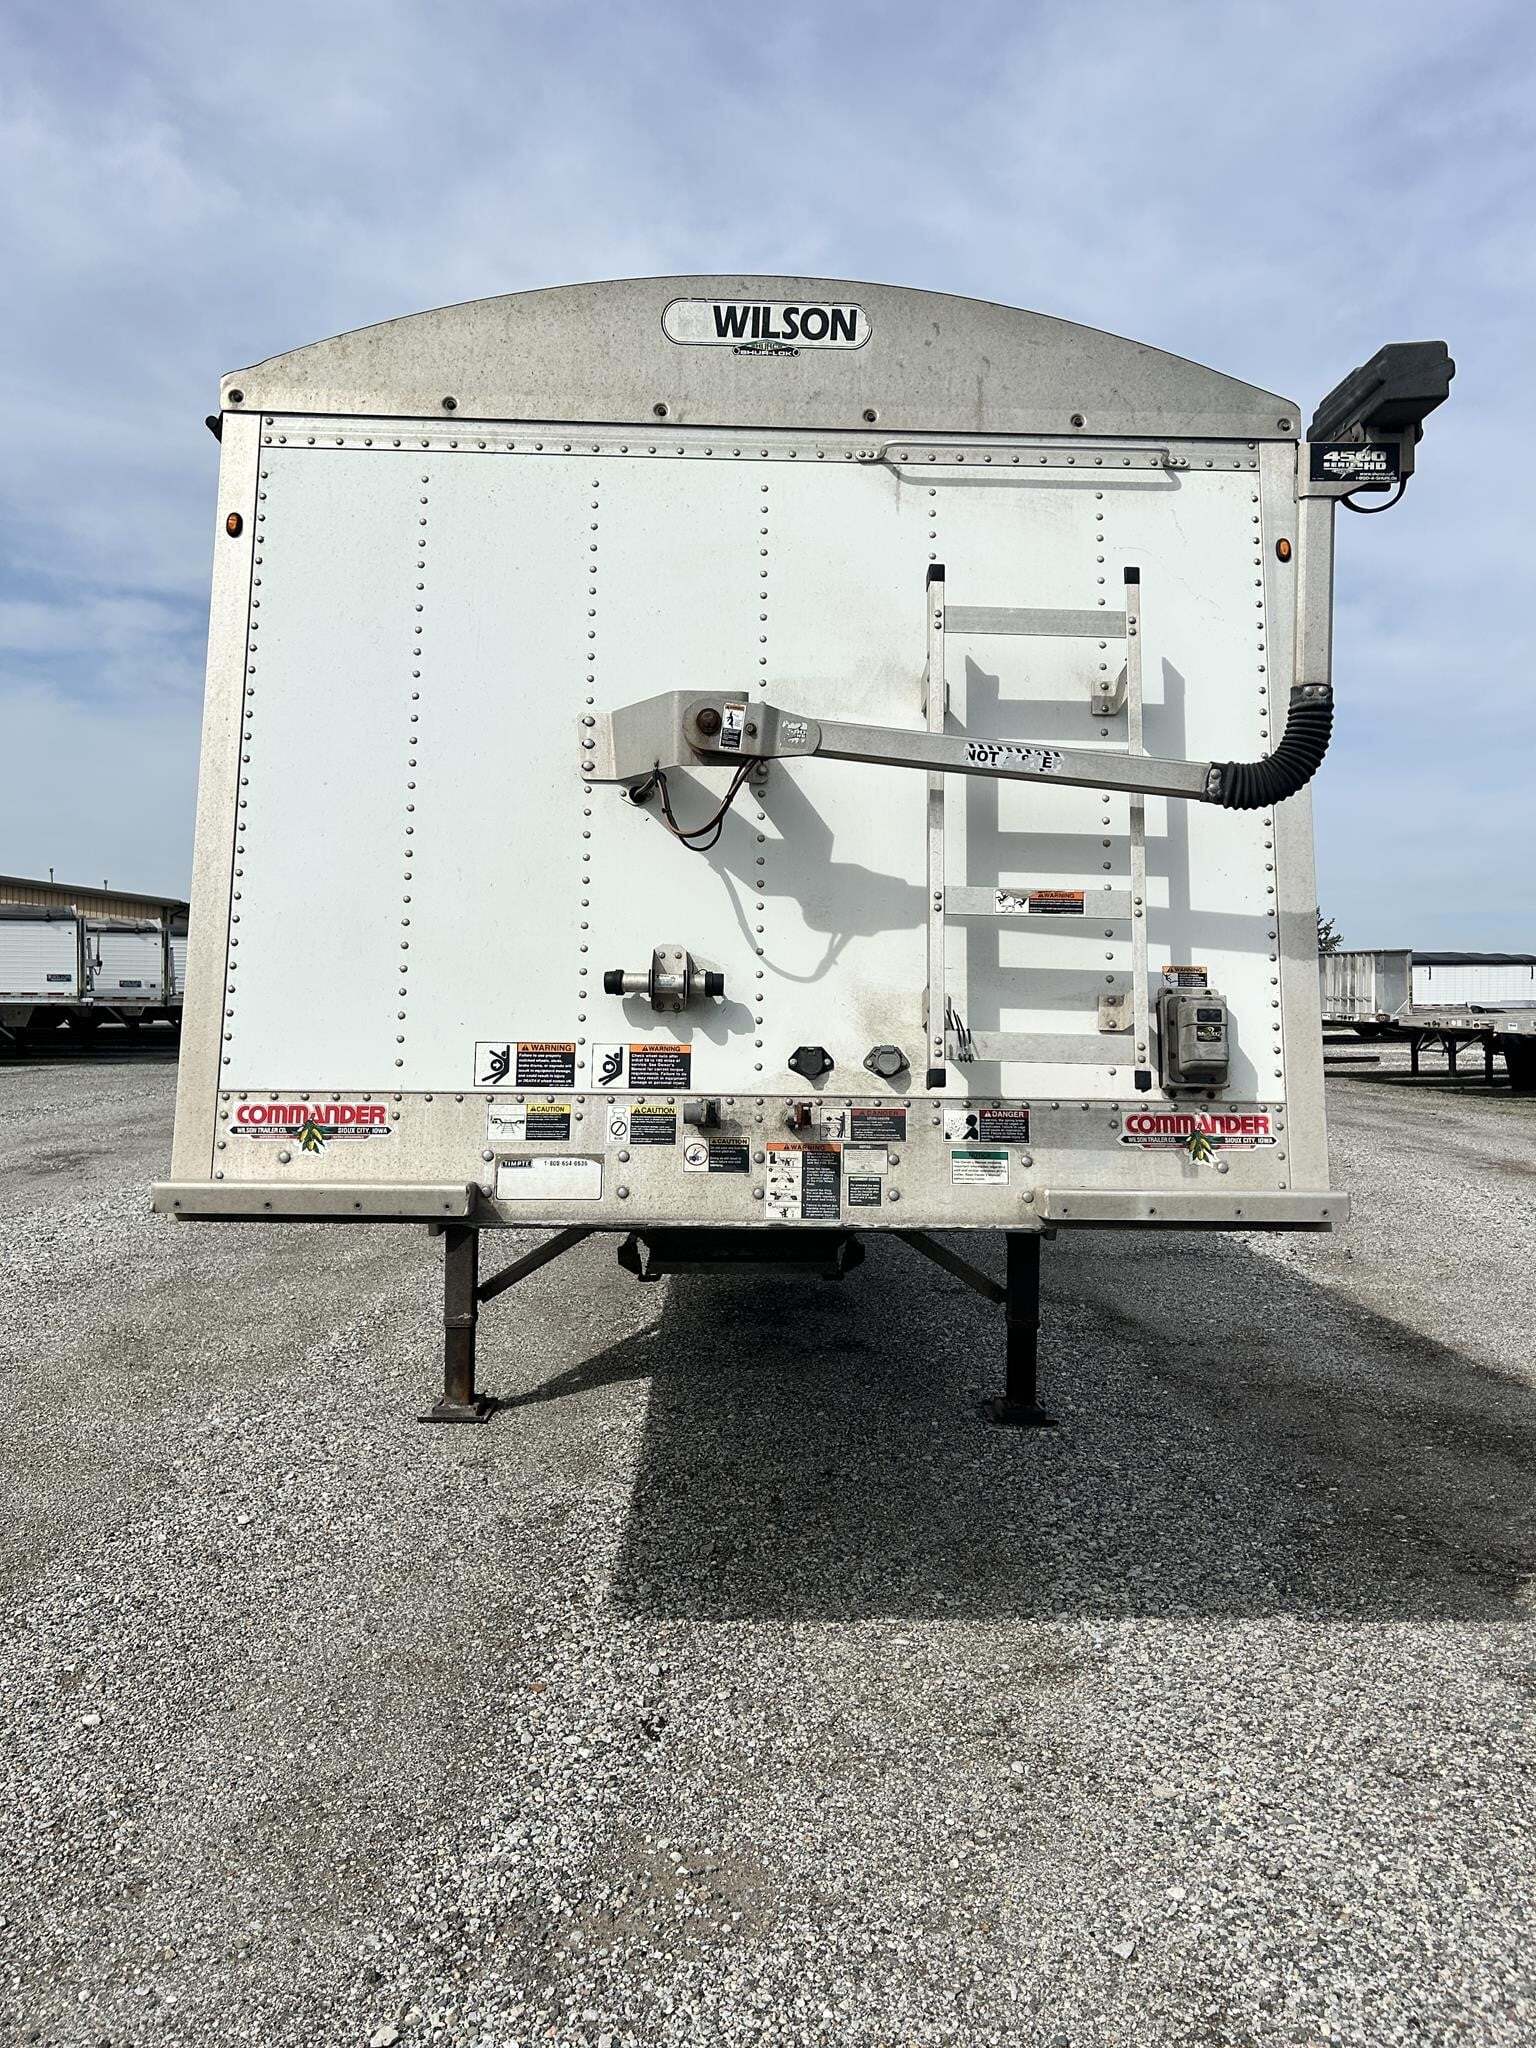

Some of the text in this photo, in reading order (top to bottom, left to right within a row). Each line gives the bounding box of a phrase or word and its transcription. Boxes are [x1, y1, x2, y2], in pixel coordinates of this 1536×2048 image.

[713, 305, 857, 341] WILSON
[1364, 462, 1387, 470] HD
[968, 749, 999, 763] NOT
[536, 1105, 565, 1113] CAUTION
[641, 1106, 675, 1114] CAUTION
[237, 1104, 386, 1124] COMMANDER
[1125, 1115, 1270, 1134] COMMANDER
[356, 1127, 371, 1135] CITY,
[372, 1127, 388, 1135] IOWA
[1243, 1137, 1257, 1145] CITY,
[790, 1143, 826, 1151] WARNING
[503, 1160, 531, 1168] TIMPTE
